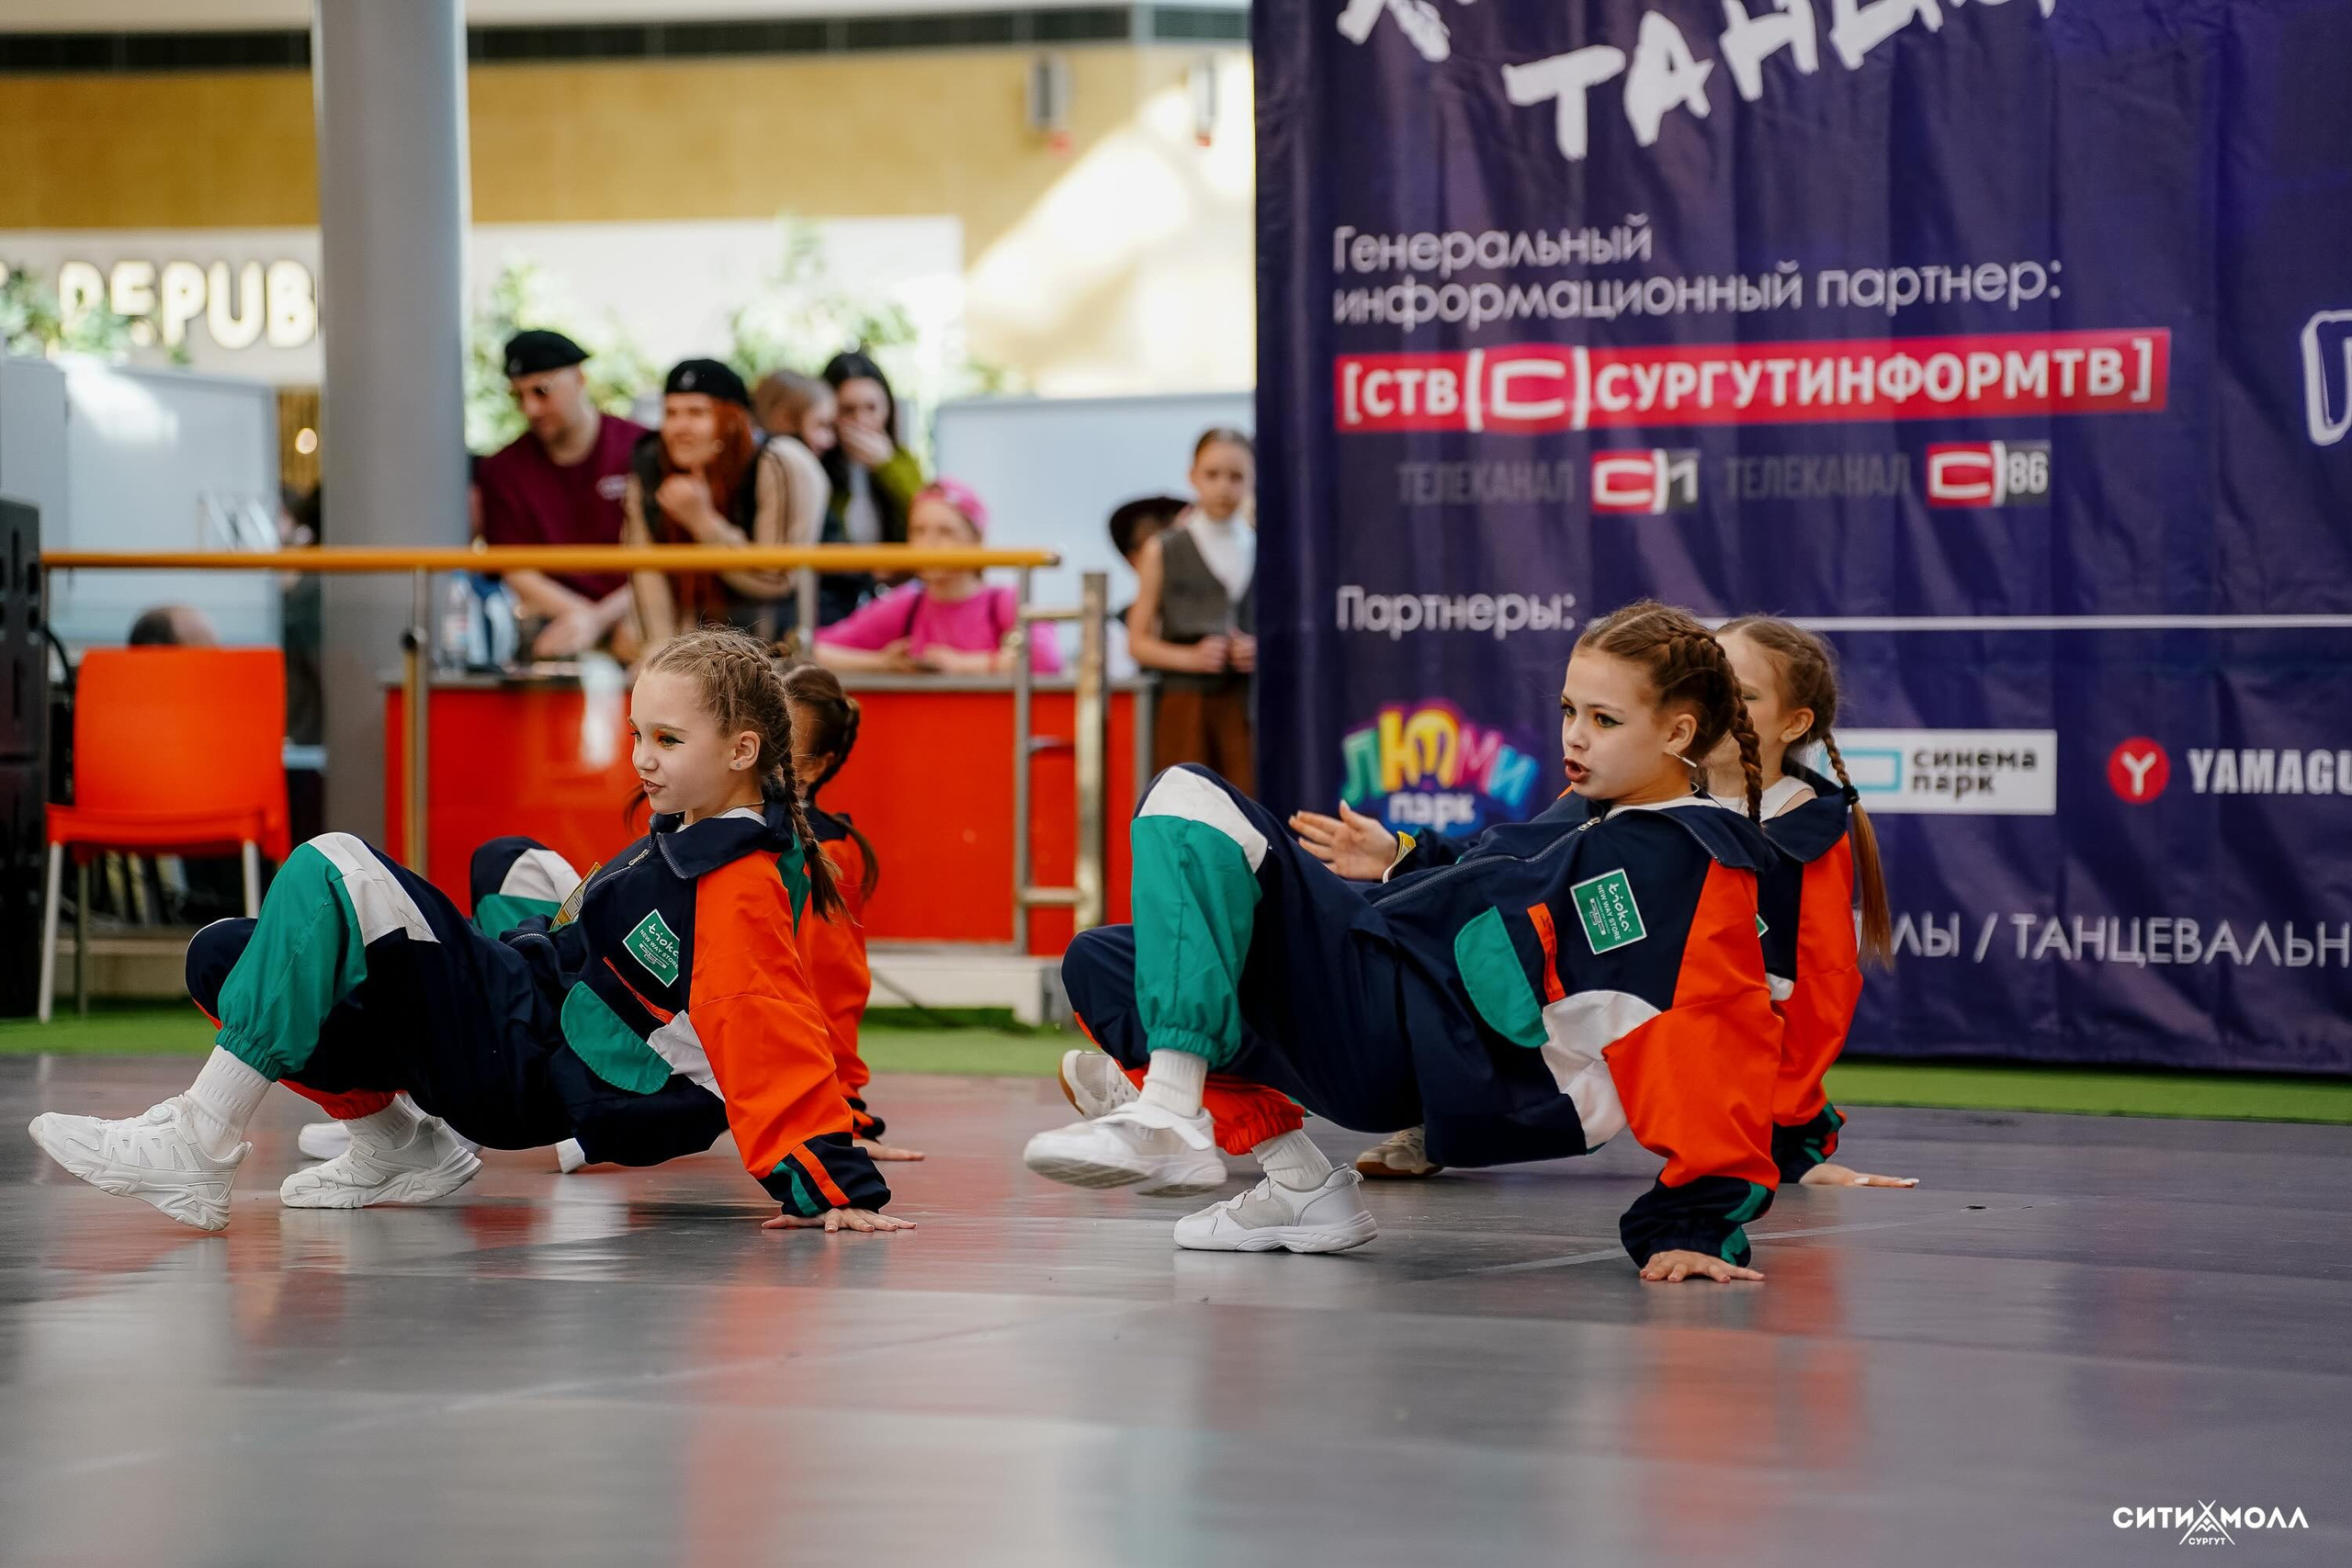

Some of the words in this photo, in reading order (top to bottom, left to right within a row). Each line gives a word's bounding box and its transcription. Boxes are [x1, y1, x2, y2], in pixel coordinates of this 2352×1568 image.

[1332, 212, 1653, 279] Генеральный
[1332, 258, 1804, 333] информационный
[1816, 259, 2063, 317] партнер:
[1336, 585, 1577, 640] Партнеры:
[1912, 749, 2038, 770] синема
[1387, 792, 1476, 833] парк
[1912, 774, 1994, 801] парк
[1597, 884, 1607, 901] NEW
[1602, 901, 1613, 918] WAY
[1609, 918, 1622, 942] STORE
[1852, 909, 1960, 957] ЛЫ
[2011, 912, 2351, 968] ТАНЦЕВАЛЬН
[639, 929, 651, 942] NEW
[650, 941, 662, 953] WAY
